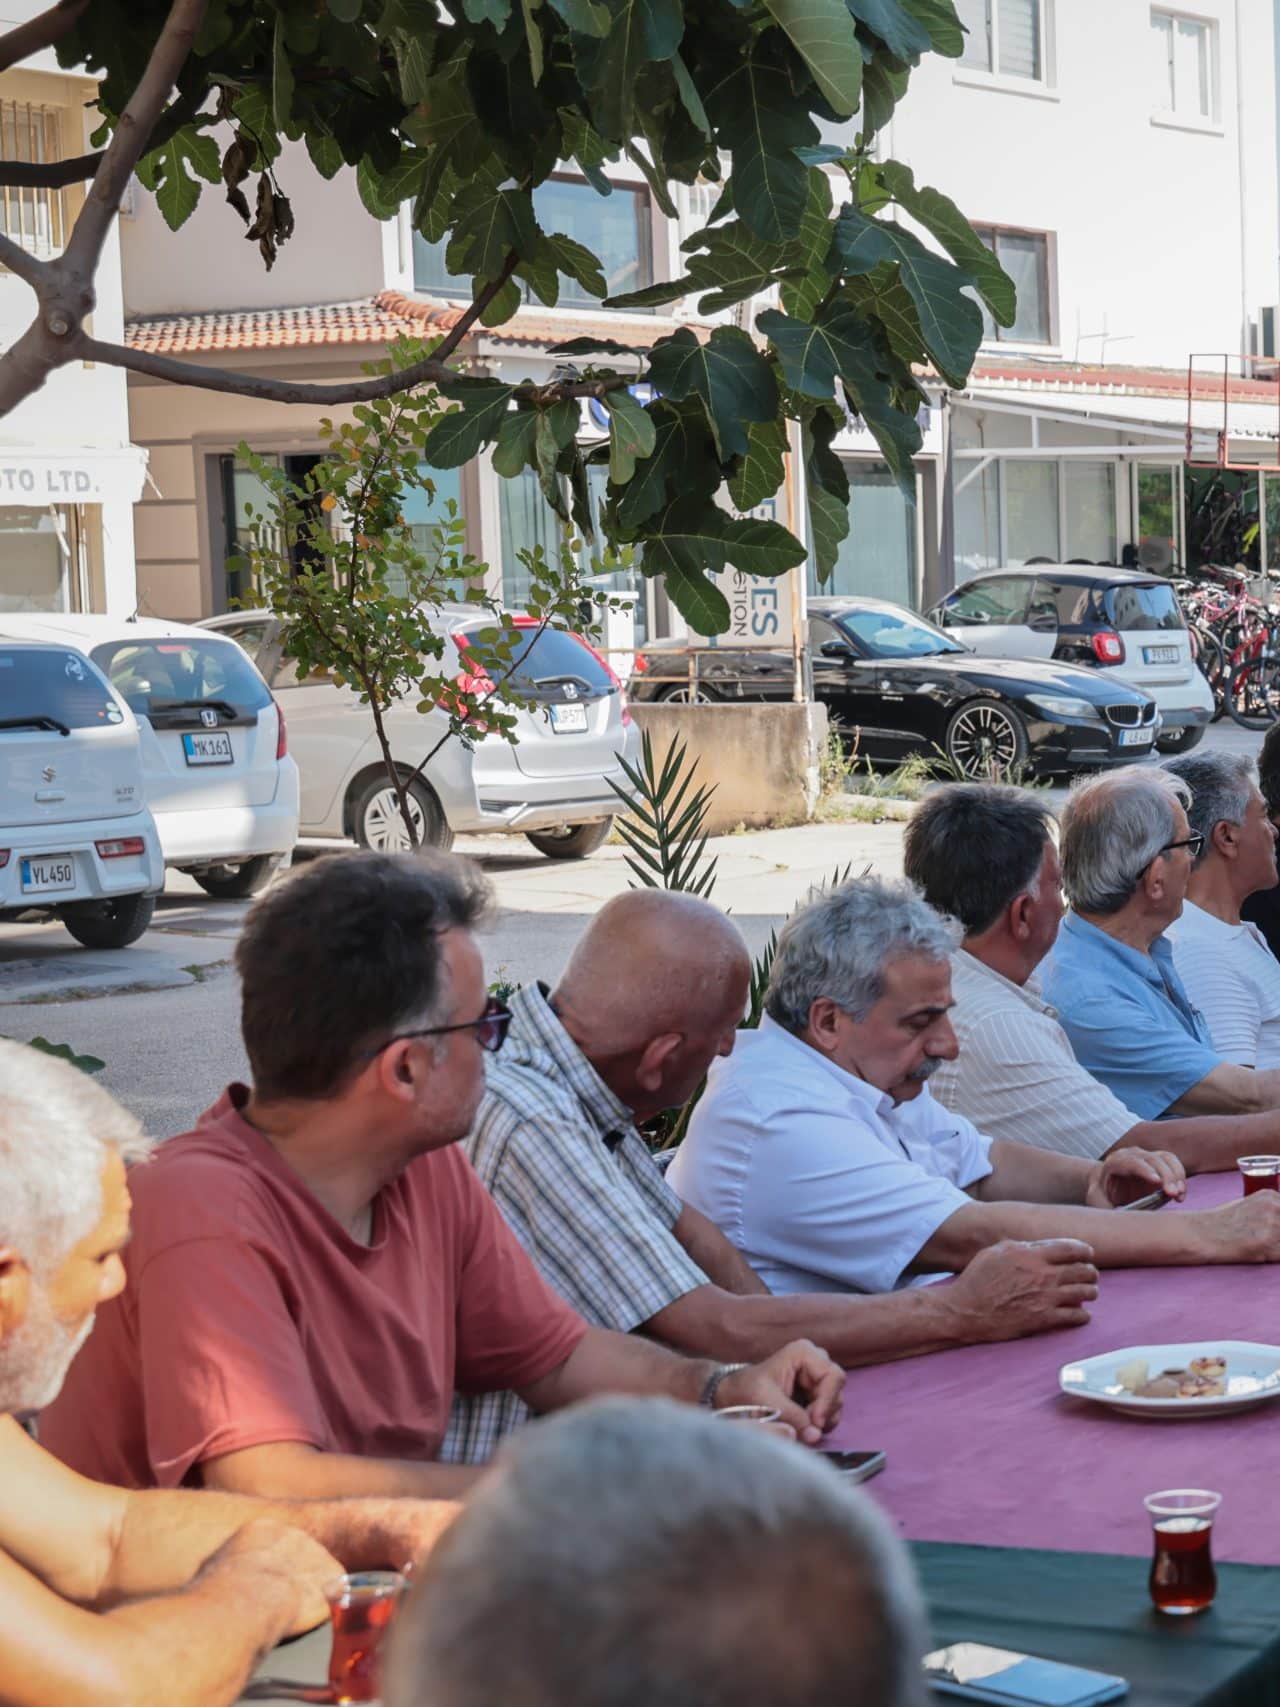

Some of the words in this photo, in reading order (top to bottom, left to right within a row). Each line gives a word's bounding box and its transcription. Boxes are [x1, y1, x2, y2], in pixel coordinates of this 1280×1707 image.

[0, 468, 35, 492] TO
[46, 469, 100, 492] LTD.
[32, 864, 72, 884] YL450
